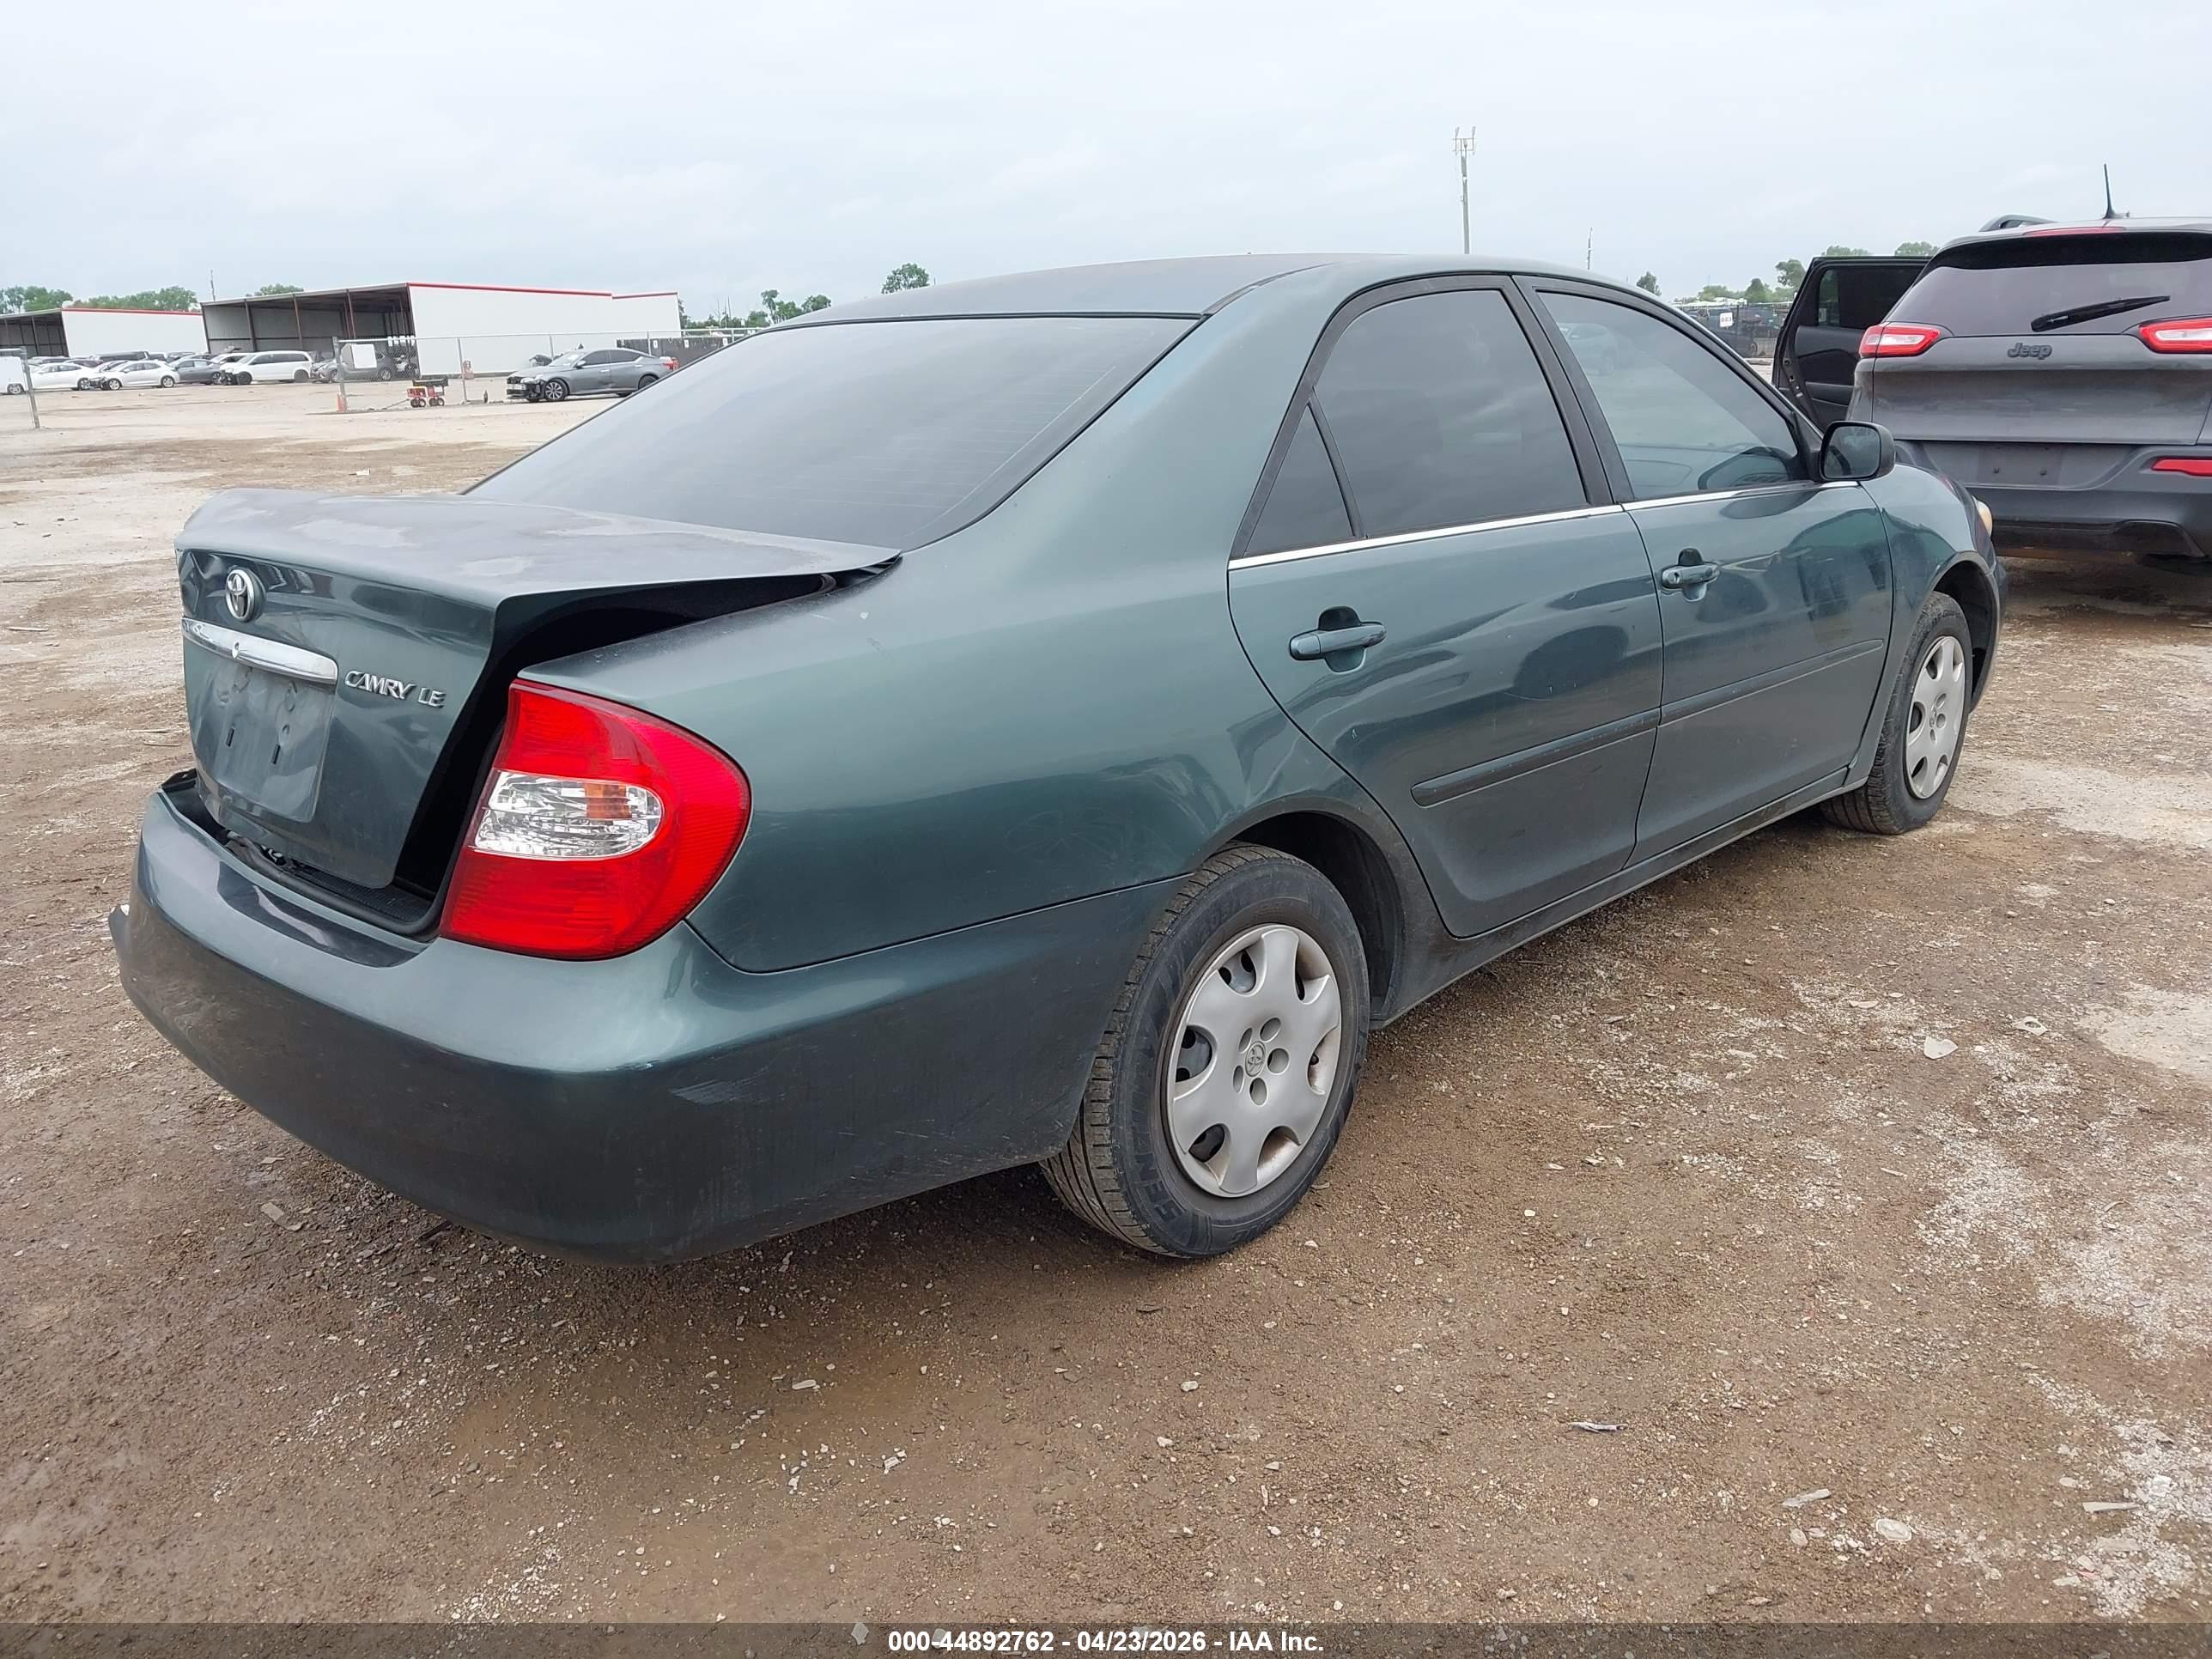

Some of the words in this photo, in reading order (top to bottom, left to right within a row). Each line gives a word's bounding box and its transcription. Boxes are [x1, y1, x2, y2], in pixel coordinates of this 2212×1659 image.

[2007, 342, 2053, 361] Jeep
[344, 670, 417, 701] CAMRY
[418, 687, 447, 708] LE
